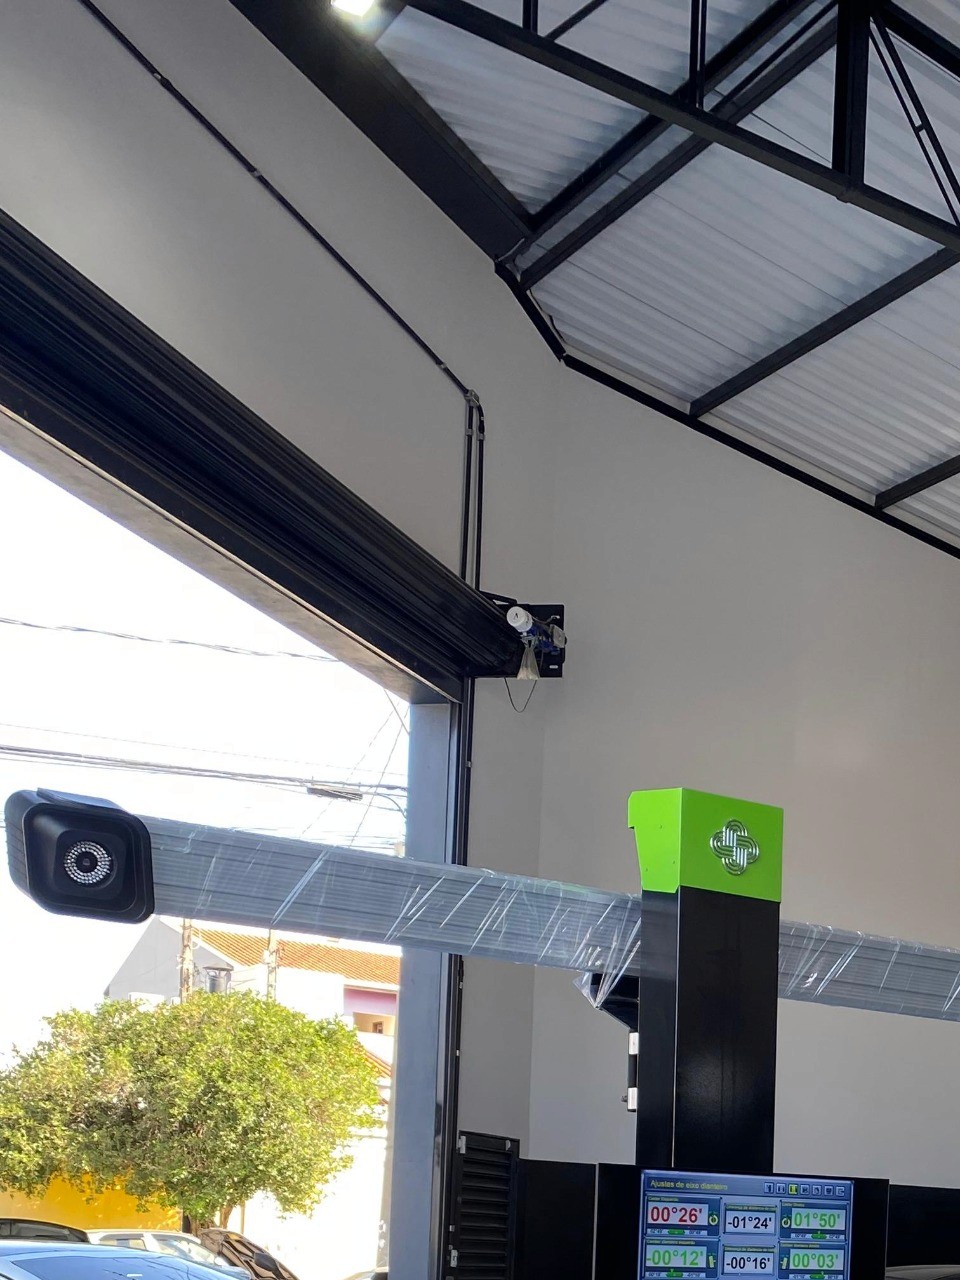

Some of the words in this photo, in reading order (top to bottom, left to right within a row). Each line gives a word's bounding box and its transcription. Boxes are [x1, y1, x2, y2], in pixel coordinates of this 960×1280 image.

[650, 1206, 702, 1223] 00°26'
[794, 1212, 841, 1228] 01°50'
[728, 1216, 772, 1229] -01°24'
[646, 1250, 703, 1265] -00°12'
[726, 1257, 770, 1269] -00°16'
[793, 1253, 838, 1268] 00°03'
